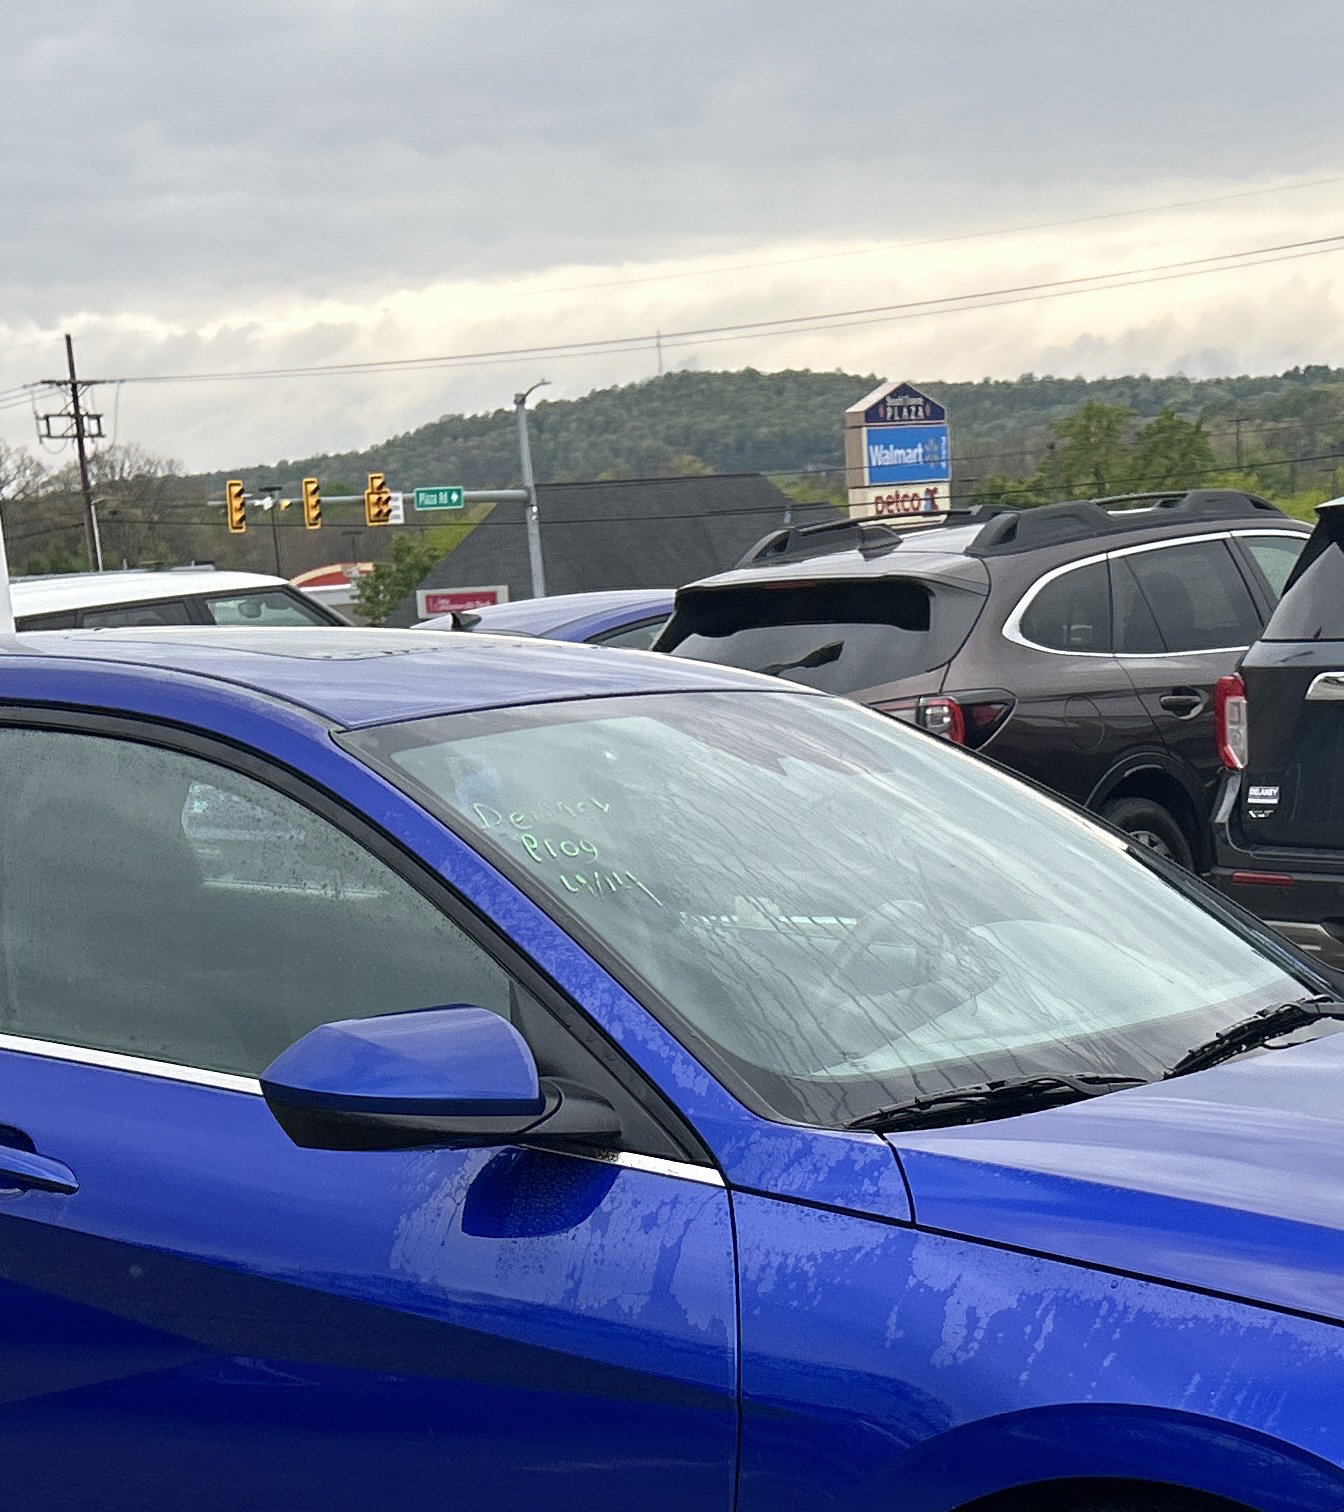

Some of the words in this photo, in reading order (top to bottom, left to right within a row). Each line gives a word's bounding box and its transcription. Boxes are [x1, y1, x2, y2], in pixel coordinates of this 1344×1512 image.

[886, 406, 924, 420] PLAZA
[869, 443, 923, 466] Walmart
[875, 490, 921, 515] petco
